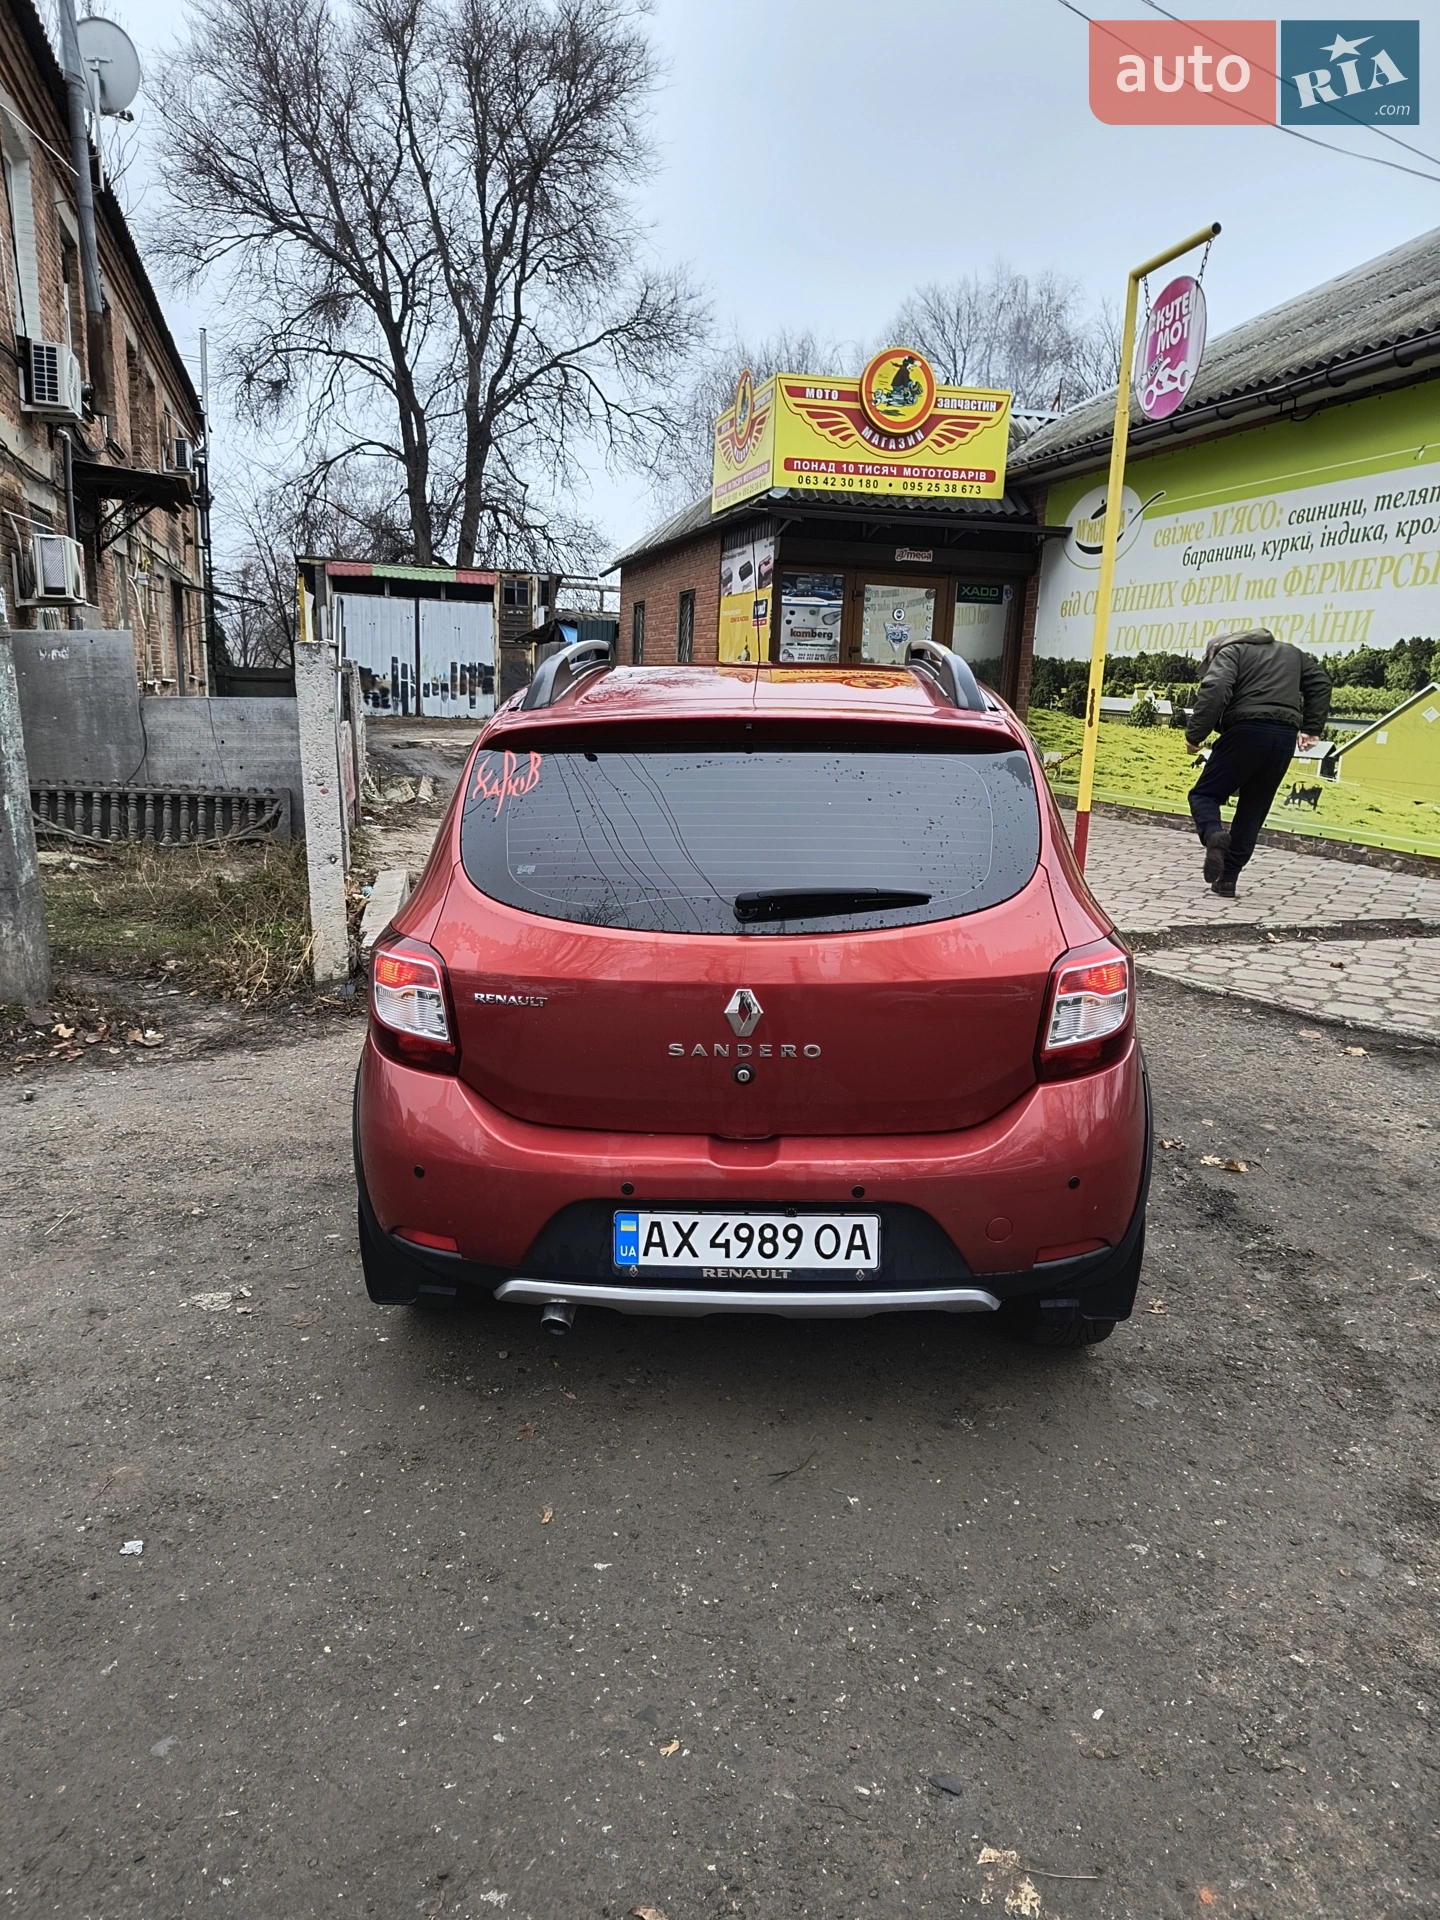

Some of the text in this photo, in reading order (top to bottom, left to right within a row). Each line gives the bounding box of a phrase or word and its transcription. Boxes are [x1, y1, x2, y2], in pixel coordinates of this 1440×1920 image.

[805, 387, 839, 400] МОТО
[861, 425, 925, 450] МАГАЗИН
[794, 460, 987, 480] ПОНАД 10 ТИСЯЧ МОТОТОВАРІВ
[798, 475, 981, 494] 063 42 30 180 095 25 38 673
[1153, 517, 1204, 548] свіже
[1288, 499, 1367, 526] свинини,
[1182, 545, 1256, 571] баранини,
[1261, 531, 1314, 562] курки,
[1320, 521, 1388, 548] індика,
[961, 586, 999, 597] XADO
[1060, 591, 1081, 618] від
[1083, 578, 1179, 615] СІЕЙНИХ
[1181, 573, 1243, 607] ФЕРМ
[1245, 577, 1277, 600] та
[790, 628, 833, 640] kamberg
[474, 992, 548, 1008] RENAULT
[668, 1043, 823, 1059] SANDERO
[620, 1221, 871, 1260] UA AX 4989 OA
[702, 1268, 792, 1279] RENAULT
